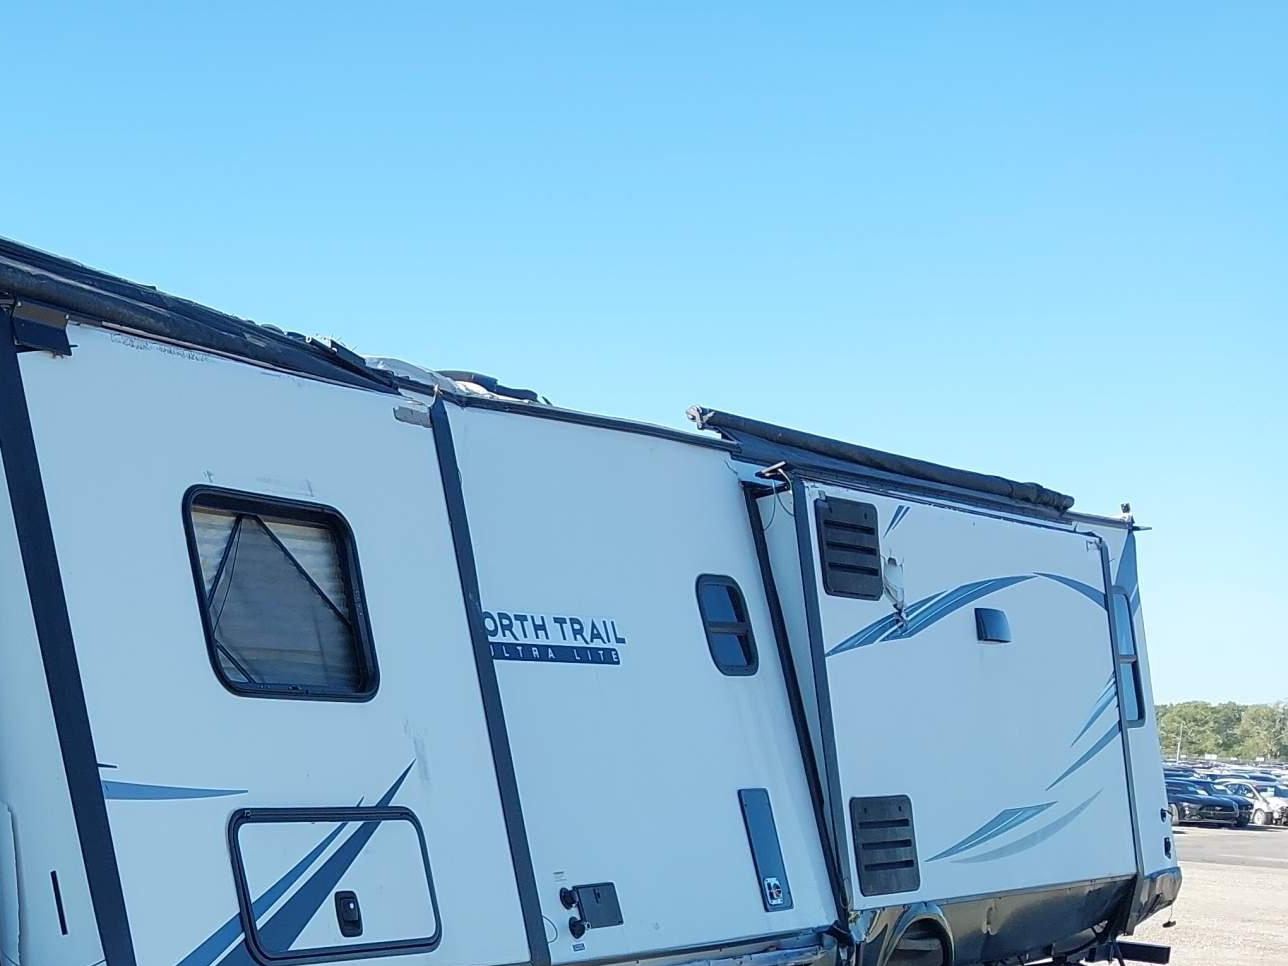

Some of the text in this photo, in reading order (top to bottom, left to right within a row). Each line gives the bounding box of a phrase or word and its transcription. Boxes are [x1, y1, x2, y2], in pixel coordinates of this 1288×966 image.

[482, 611, 627, 645] ORTH TRAIL
[573, 649, 619, 662] LITE
